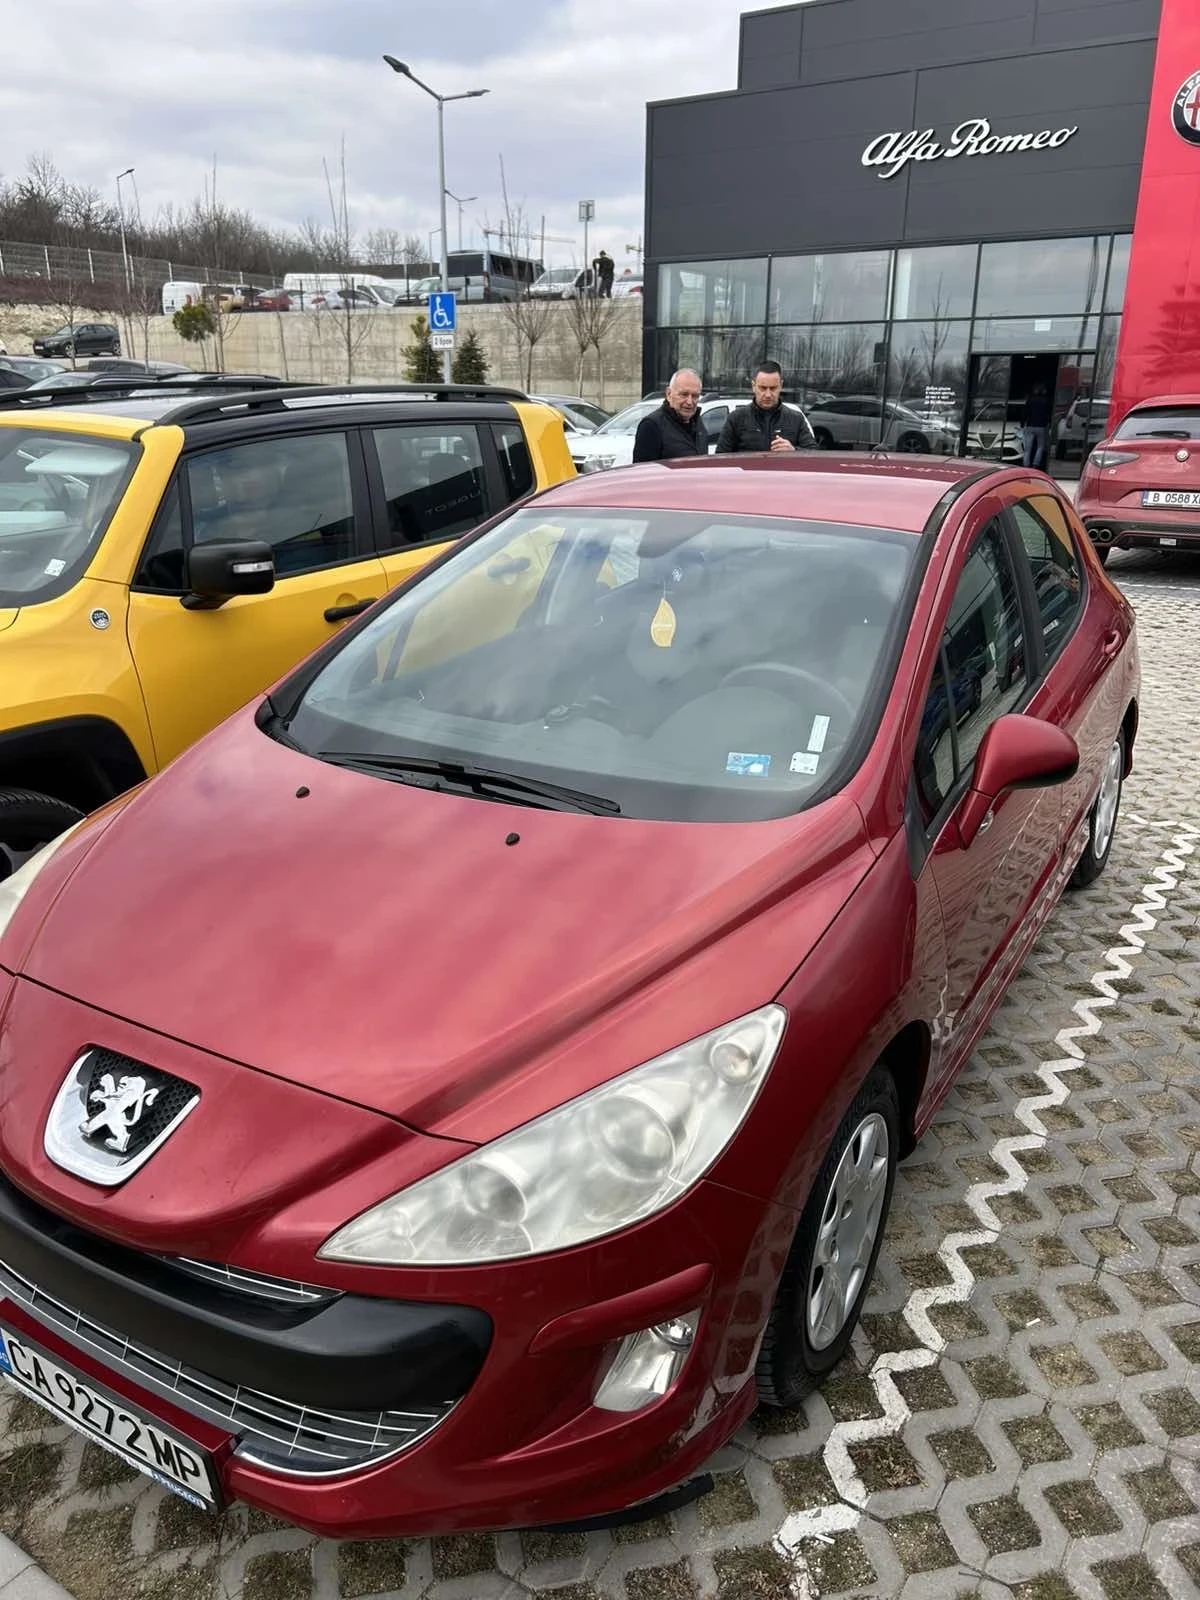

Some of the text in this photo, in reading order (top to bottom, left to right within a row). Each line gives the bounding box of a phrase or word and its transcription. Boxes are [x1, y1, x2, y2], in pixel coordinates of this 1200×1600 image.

[861, 118, 1078, 179] Alfa Romeo
[1153, 492, 1200, 504] B 0588 X
[8, 1340, 54, 1398] CA
[55, 1373, 147, 1456] 9272
[147, 1429, 201, 1483] MP
